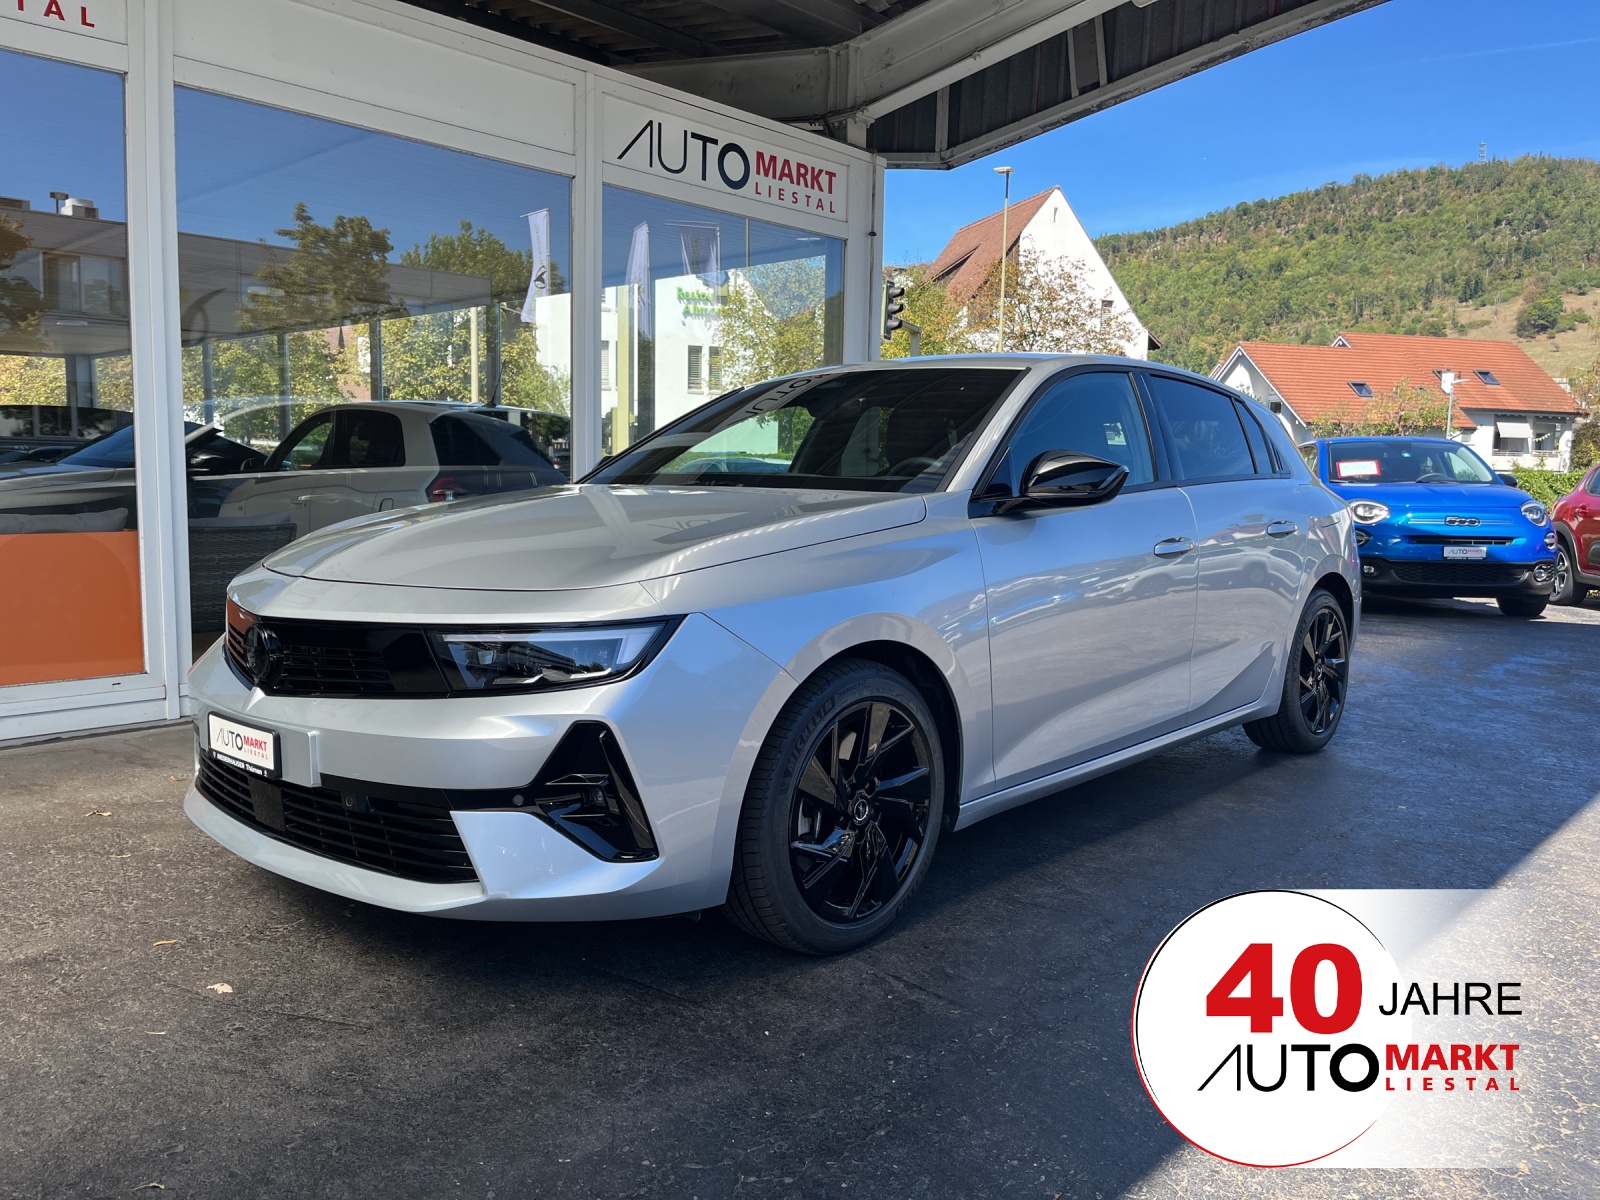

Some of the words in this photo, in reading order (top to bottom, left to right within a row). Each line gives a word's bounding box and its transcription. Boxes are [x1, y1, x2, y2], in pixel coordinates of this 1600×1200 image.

[616, 119, 750, 190] AUTO
[755, 150, 837, 194] MARKT
[755, 181, 836, 214] LIESTAL
[1445, 516, 1479, 526] 500
[216, 727, 243, 751] AUTO
[243, 735, 267, 752] MARKT
[787, 697, 834, 773] MICHELIN
[244, 746, 269, 760] LIESTAL
